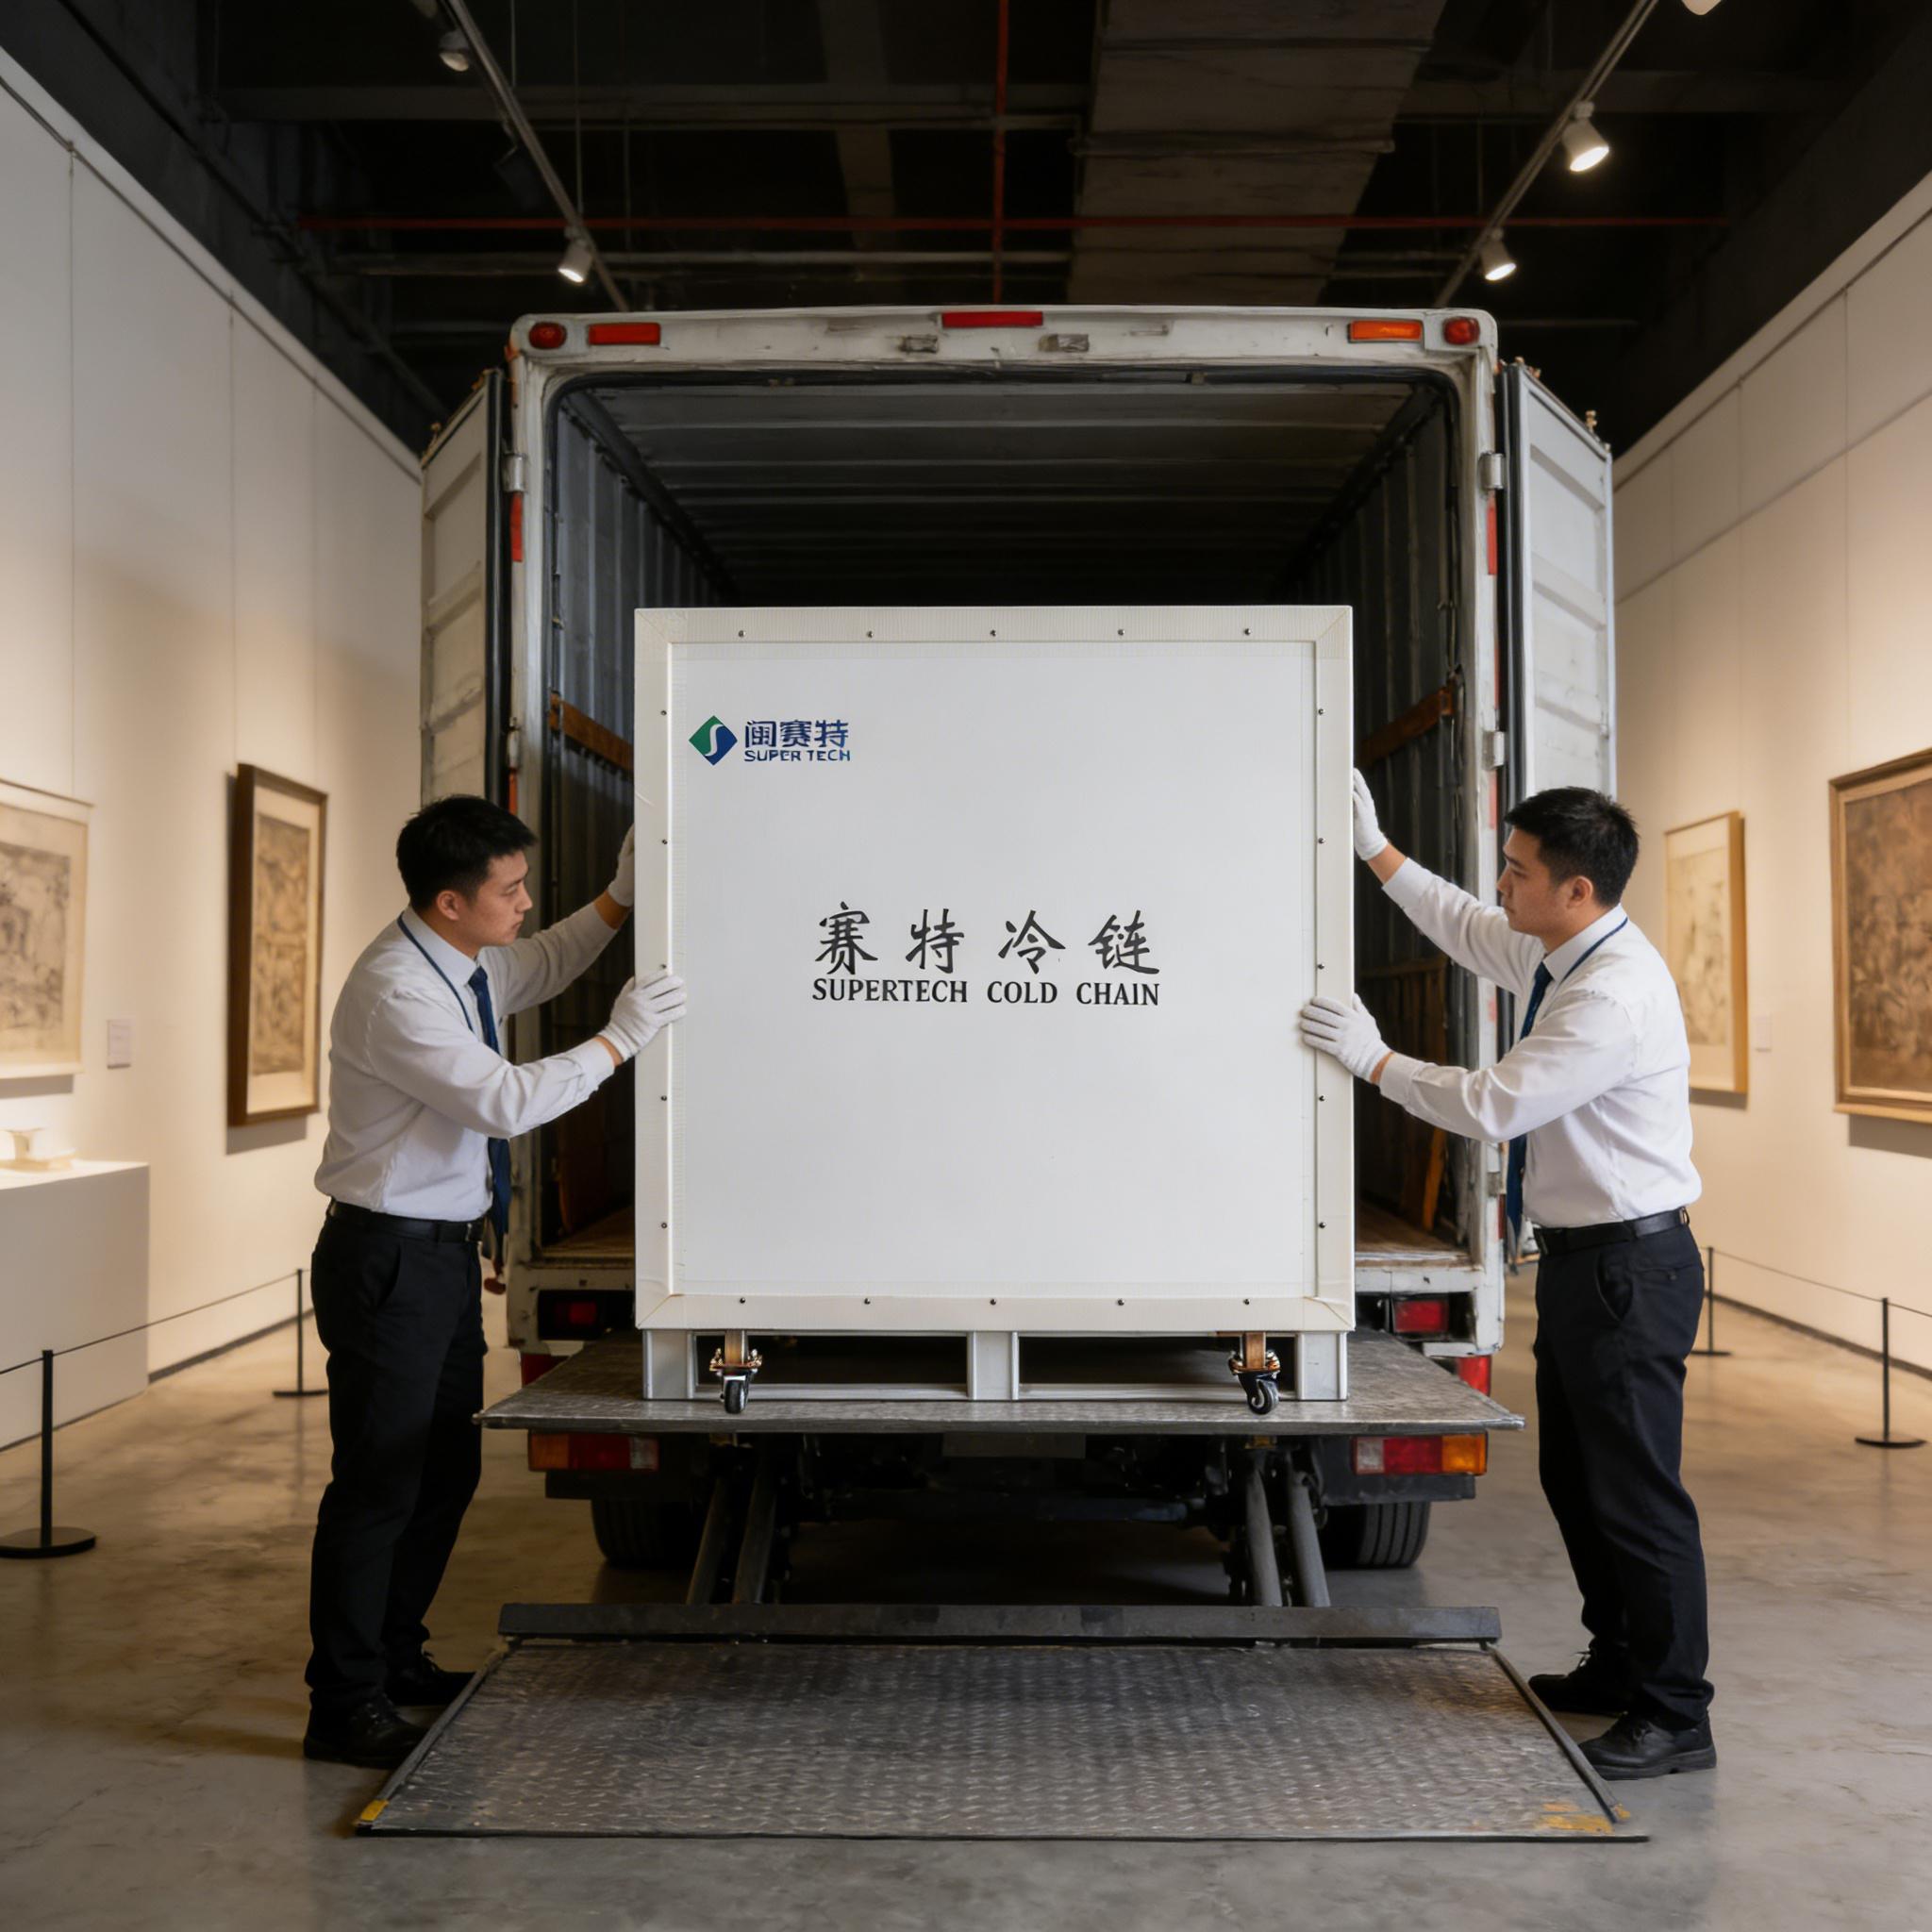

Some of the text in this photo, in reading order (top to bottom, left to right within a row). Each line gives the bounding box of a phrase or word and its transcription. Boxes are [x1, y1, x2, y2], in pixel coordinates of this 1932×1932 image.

[814, 901, 1159, 974] 赛特冷链
[811, 978, 1159, 1006] SUPERTECH COLD CHAIN
